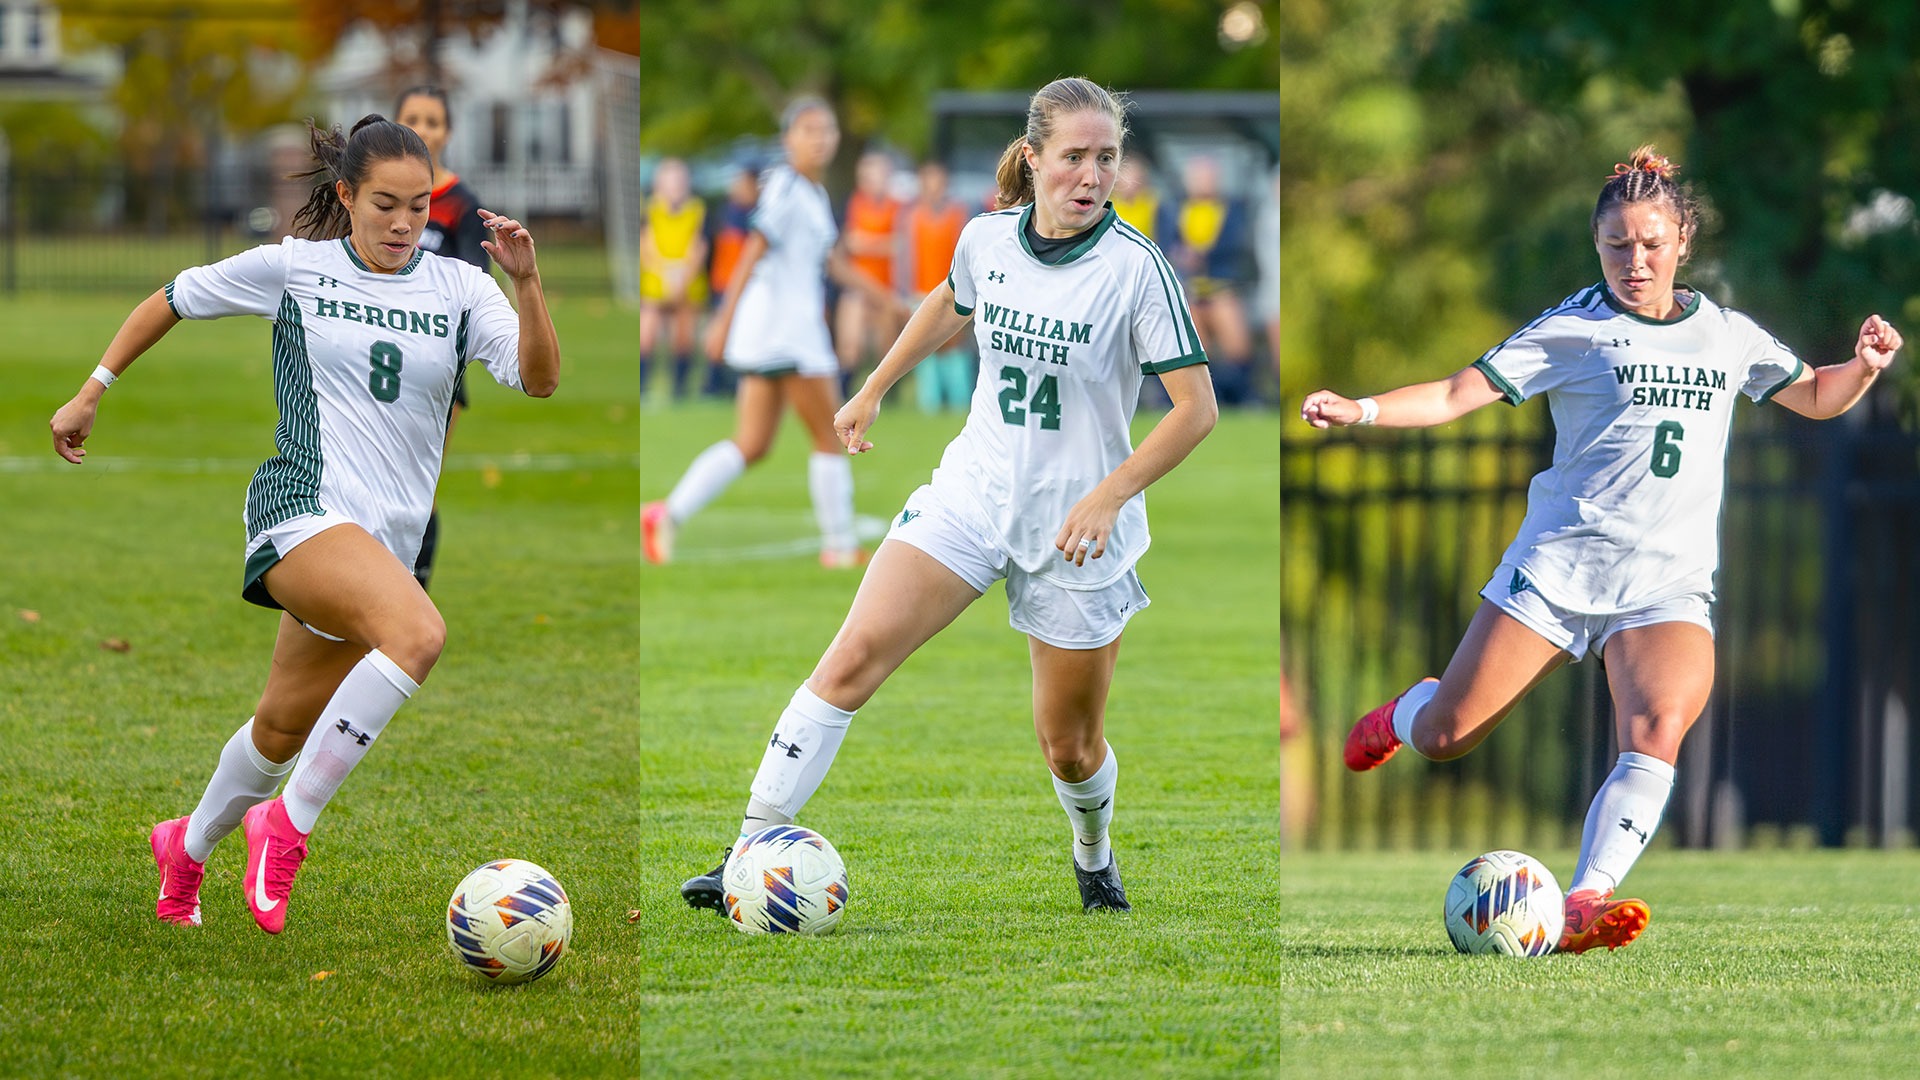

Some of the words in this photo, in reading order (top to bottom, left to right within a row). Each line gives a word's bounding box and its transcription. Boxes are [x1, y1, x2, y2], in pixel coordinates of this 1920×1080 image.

[315, 296, 448, 338] HERONS
[983, 301, 1093, 344] WILLIAM
[991, 330, 1070, 366] SMITH
[369, 339, 403, 404] 8
[1613, 364, 1726, 390] WILLIAM
[998, 365, 1061, 430] 24
[1633, 387, 1713, 411] SMITH
[1650, 419, 1684, 479] 6
